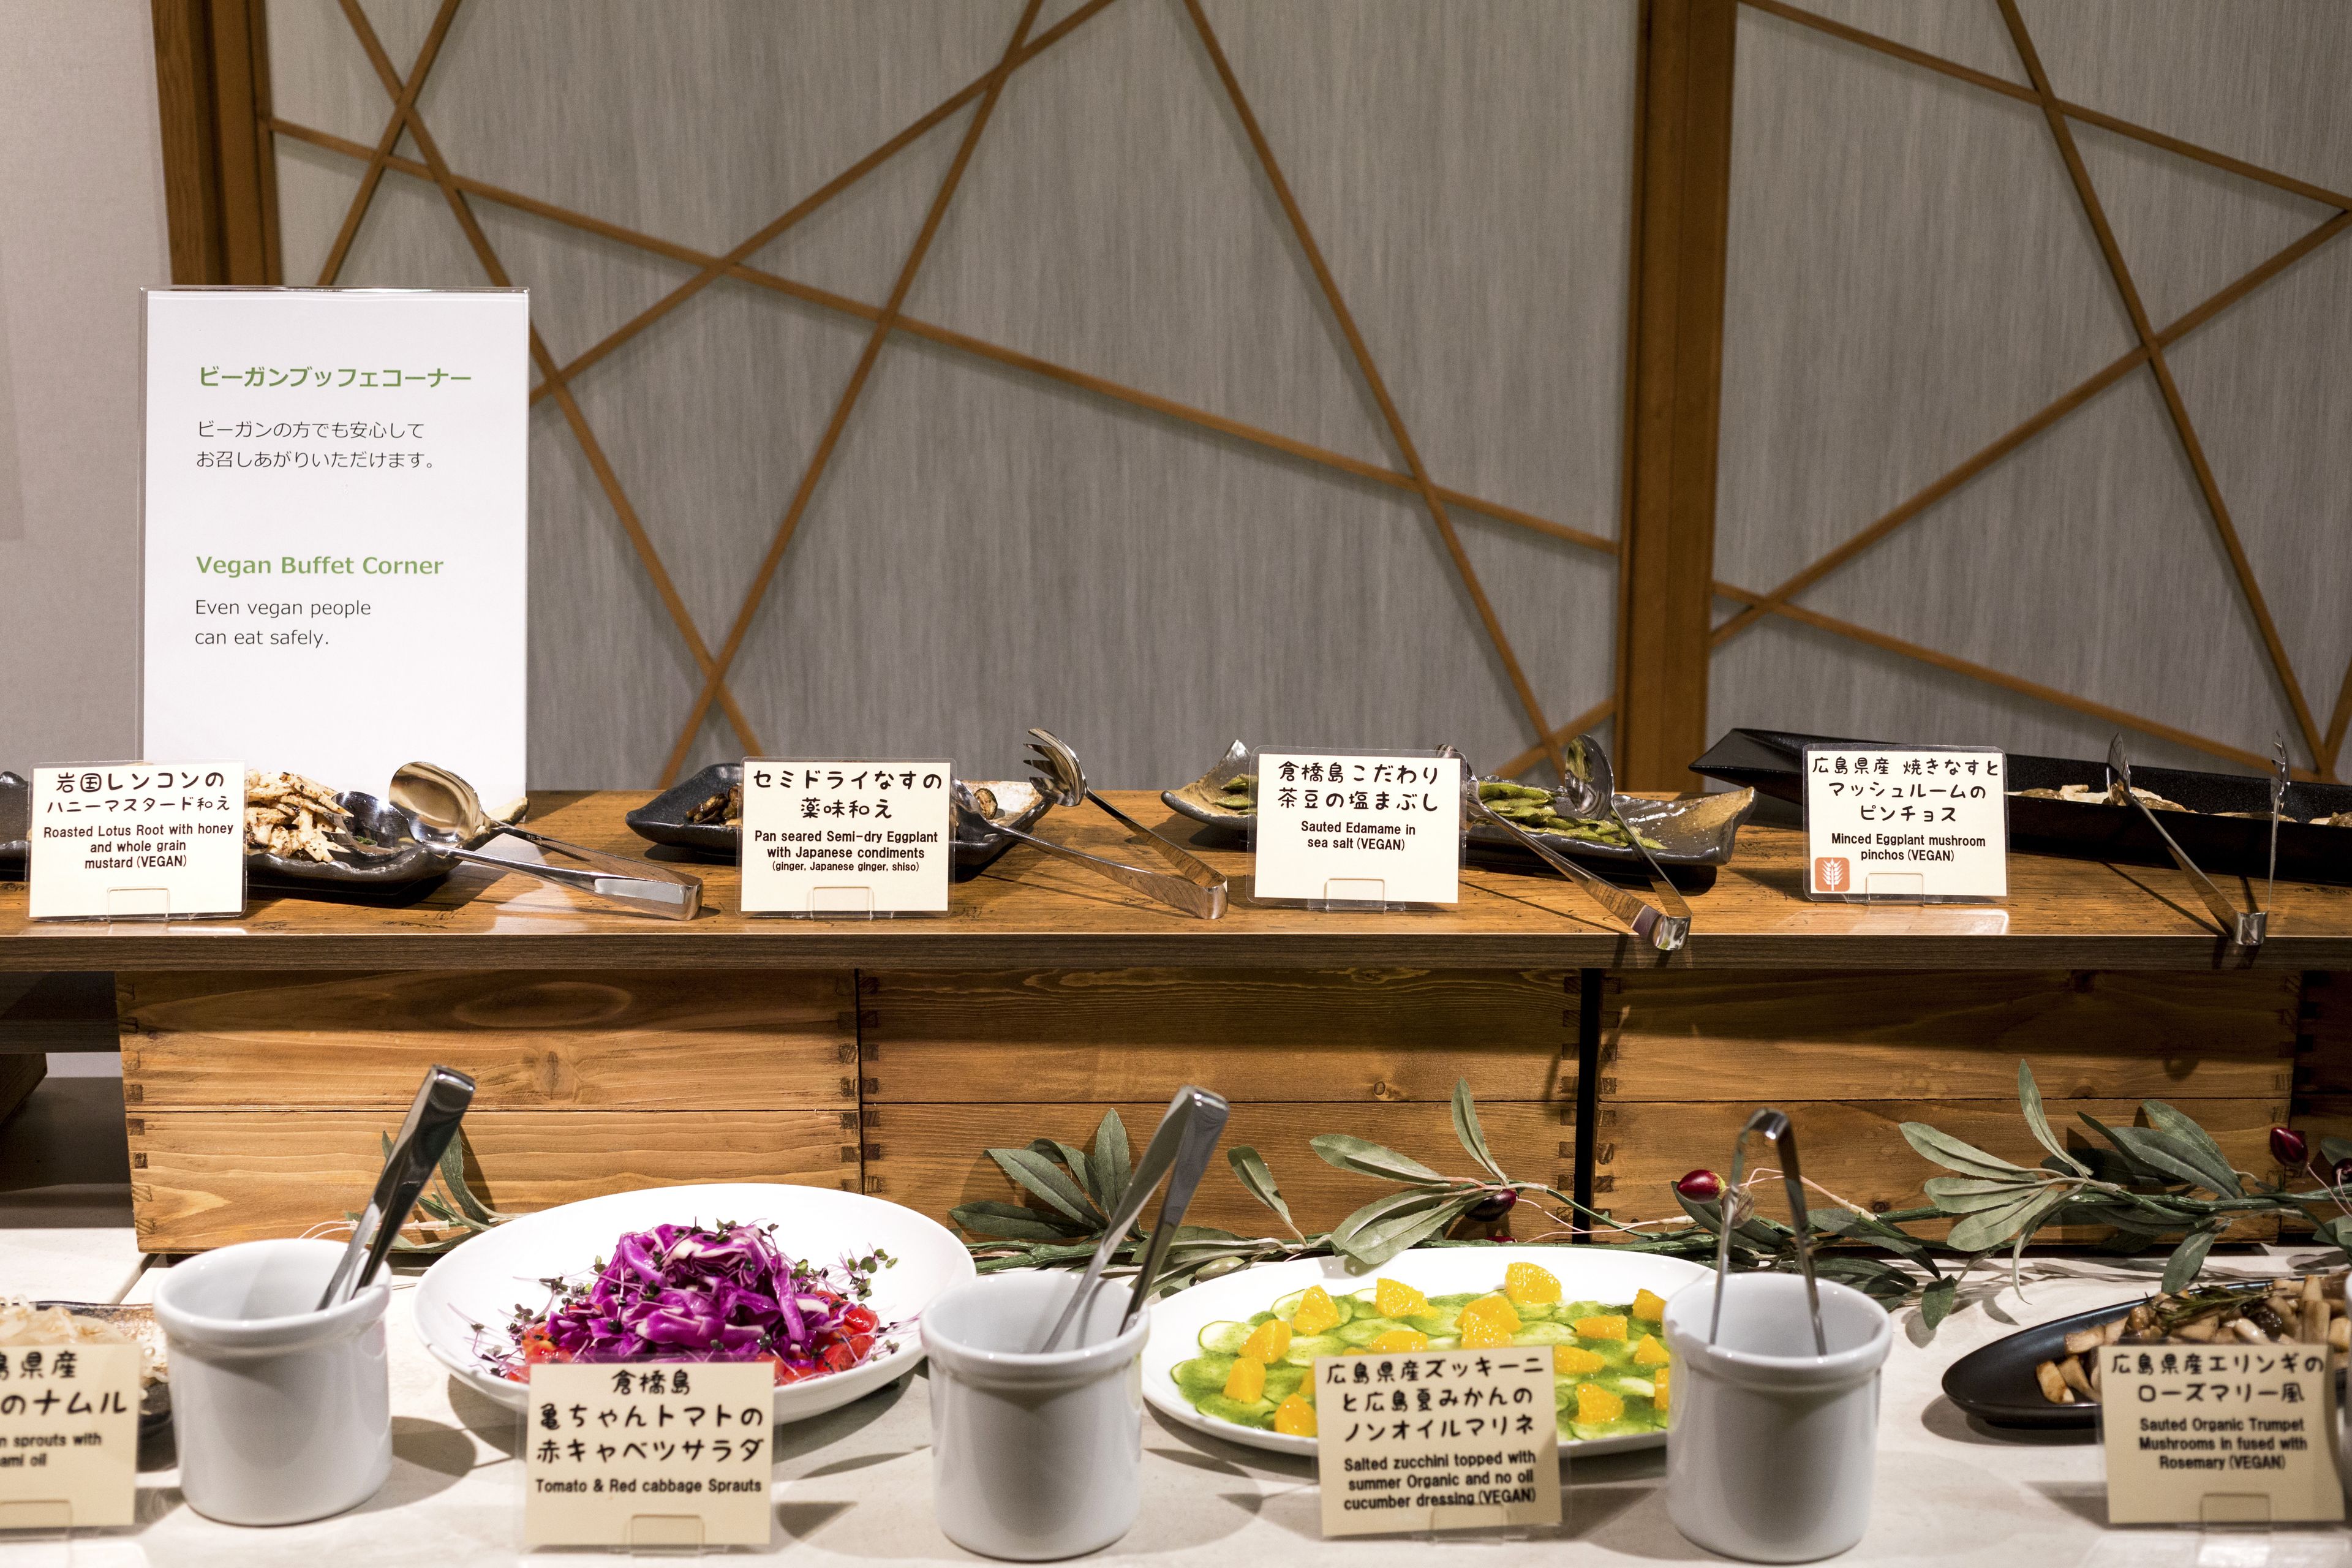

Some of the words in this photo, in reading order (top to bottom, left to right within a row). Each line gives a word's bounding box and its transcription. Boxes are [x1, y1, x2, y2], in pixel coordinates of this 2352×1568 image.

[200, 366, 472, 388] ビーガンブッフェコーナー
[199, 420, 424, 439] ビーガンの方でも安心して
[197, 450, 432, 469] お召しあがりいただけます。
[196, 556, 271, 578] Vegan
[282, 556, 355, 575] Buffet
[363, 556, 444, 575] Corner
[196, 600, 239, 615] Even
[247, 603, 303, 619] vegan
[311, 600, 371, 619] people
[195, 633, 226, 645] can
[234, 630, 263, 645] eat
[270, 629, 328, 649] safely.
[1278, 761, 1438, 785] 倉橋島こだわり
[1812, 756, 1890, 775] 広島県産
[1903, 758, 1998, 776] 焼きなすと
[56, 772, 224, 793] 岩国レンコンの
[753, 769, 942, 790] セミドライなすの
[1277, 786, 1438, 812] 茶豆の塩まぶし
[1828, 782, 1986, 799] マッシュルームの
[47, 795, 230, 813] ハニーマスタード和え
[801, 797, 892, 819] 薬味和え
[1861, 804, 1956, 823] ピンチョス
[43, 826, 93, 838] Roasted
[98, 825, 131, 837] Lotus
[136, 824, 164, 836] Root
[168, 823, 193, 835] with
[198, 823, 234, 835] honey
[755, 830, 777, 842] Pan
[781, 830, 822, 842] seared
[826, 830, 883, 843] Semi-dry
[887, 831, 938, 844] Eggplant
[1301, 820, 1341, 833] Sauted
[1346, 821, 1401, 835] Edamame
[1406, 824, 1415, 835] in
[90, 841, 112, 853] and
[116, 840, 152, 852] whole
[156, 839, 186, 853] grain
[1307, 839, 1328, 848] sea
[1333, 837, 1354, 849] salt
[1357, 837, 1405, 851] (VEGAN)
[1831, 832, 1872, 845] Minced
[1876, 833, 1925, 846] Eggplant
[1929, 835, 1986, 847] mushroom
[85, 856, 133, 869] mustard
[137, 854, 187, 868] (VEGAN)
[767, 846, 791, 858] with
[795, 846, 853, 859] Japanese
[857, 846, 925, 859] condiments
[1861, 848, 1904, 861] pinchos
[1907, 848, 1954, 862] (VEGAN)
[772, 861, 806, 872] (ginger,
[810, 861, 854, 872] Japanese
[858, 862, 888, 872] ginger,
[892, 861, 919, 872] shiso)
[1327, 1357, 1544, 1384] 広島県産ズッキーニ
[2111, 1352, 2324, 1376] 広島県産エリンギの
[612, 1368, 690, 1395] 倉橋島
[0, 1389, 127, 1415] のナムル
[1343, 1387, 1532, 1412] と広島夏みかんの
[2138, 1382, 2305, 1403] ローズマリー風
[540, 1403, 763, 1431] 亀ちゃんトマトの
[2139, 1417, 2187, 1431] Sauted
[2192, 1417, 2244, 1433] Organic
[2248, 1417, 2304, 1433] Trumpet
[1345, 1414, 1533, 1442] ノンオイルマリネ
[537, 1438, 764, 1464] 赤キャベツサラダ
[2139, 1436, 2216, 1450] Mushrooms
[2220, 1437, 2233, 1450] in
[2236, 1436, 2275, 1451] fused
[2279, 1437, 2308, 1450] with
[1344, 1457, 1388, 1472] Salted
[1393, 1453, 1449, 1470] zucchini
[1453, 1451, 1503, 1468] topped
[1507, 1450, 1536, 1464] with
[2159, 1455, 2226, 1471] Rosemary
[2229, 1455, 2285, 1469] (VEGAN)
[535, 1479, 587, 1493] Tomato
[593, 1478, 604, 1493] &
[609, 1478, 637, 1493] Red
[642, 1479, 703, 1494] cabbage
[708, 1478, 762, 1494] Sprauts
[1348, 1478, 1401, 1491] summer
[1406, 1472, 1460, 1489] Organic
[1465, 1471, 1490, 1486] and
[1494, 1472, 1512, 1484] no
[1517, 1469, 1534, 1483] oil
[1343, 1494, 1411, 1511] cucumber
[1416, 1491, 1476, 1507] dressing
[1478, 1487, 1536, 1505] (VEGAN)
